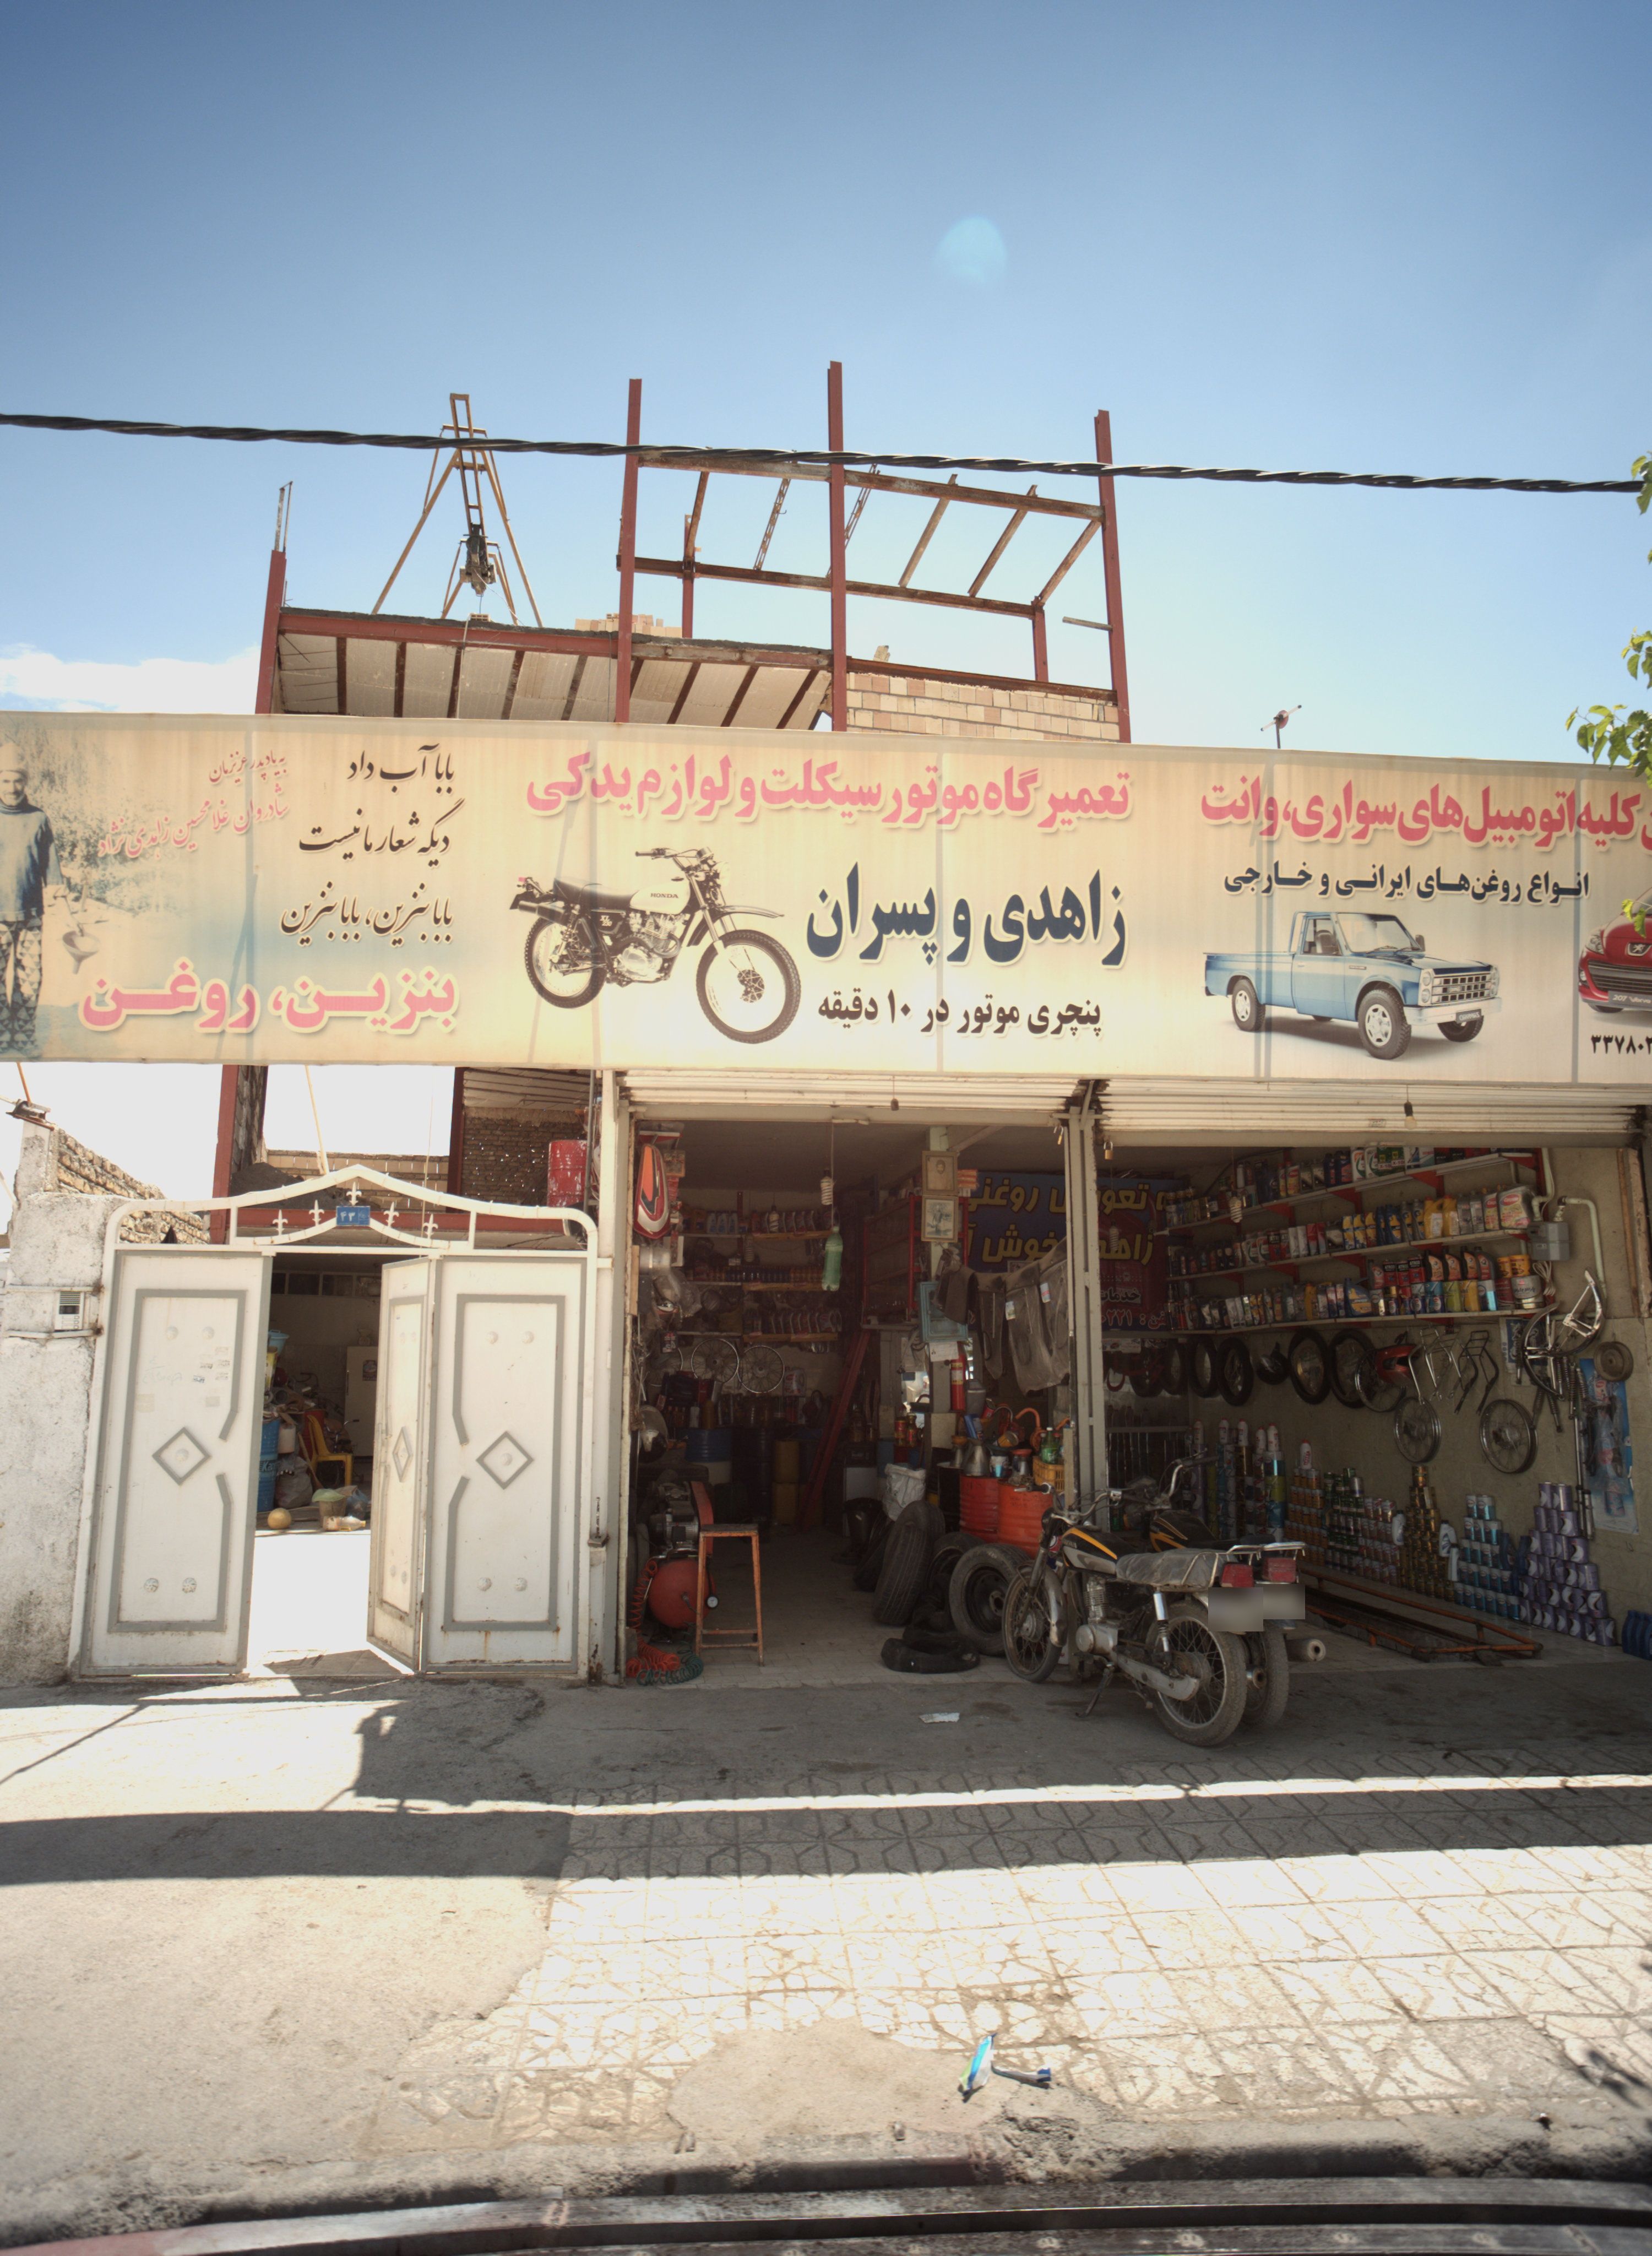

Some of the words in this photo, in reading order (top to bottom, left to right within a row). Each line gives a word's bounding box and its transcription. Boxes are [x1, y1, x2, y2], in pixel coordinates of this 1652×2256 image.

[249, 757, 267, 780] پدر
[346, 750, 374, 780] داد
[379, 743, 440, 794] آب
[435, 752, 455, 794] بابا
[526, 751, 632, 811] یدکی
[636, 753, 732, 816] لوازم
[233, 783, 288, 833] شادروان
[735, 776, 756, 818] و
[1201, 775, 1279, 836] وانت
[97, 817, 125, 856] نژاد
[126, 816, 169, 858] زاهدی
[299, 807, 363, 860] نیست
[363, 825, 373, 852] ما
[374, 811, 420, 852] شعار
[417, 798, 466, 867] دیگه
[1576, 790, 1641, 847] کلیه
[1224, 859, 1312, 894] خارجی
[1318, 872, 1330, 896] و
[1335, 863, 1410, 898] ایرانی
[1527, 870, 1589, 904] انواع
[281, 881, 338, 946] بنزین
[340, 896, 360, 941] بابا
[433, 897, 453, 942] بابا
[806, 861, 938, 965] پسران
[946, 897, 971, 962] و
[982, 868, 1126, 966] زاهدی
[83, 961, 257, 1029] روغن
[818, 987, 878, 1029] دقیقه
[887, 989, 911, 1024] ۱۰
[920, 995, 949, 1033] در
[957, 994, 1020, 1034] موتور
[1027, 999, 1101, 1037] پنچری
